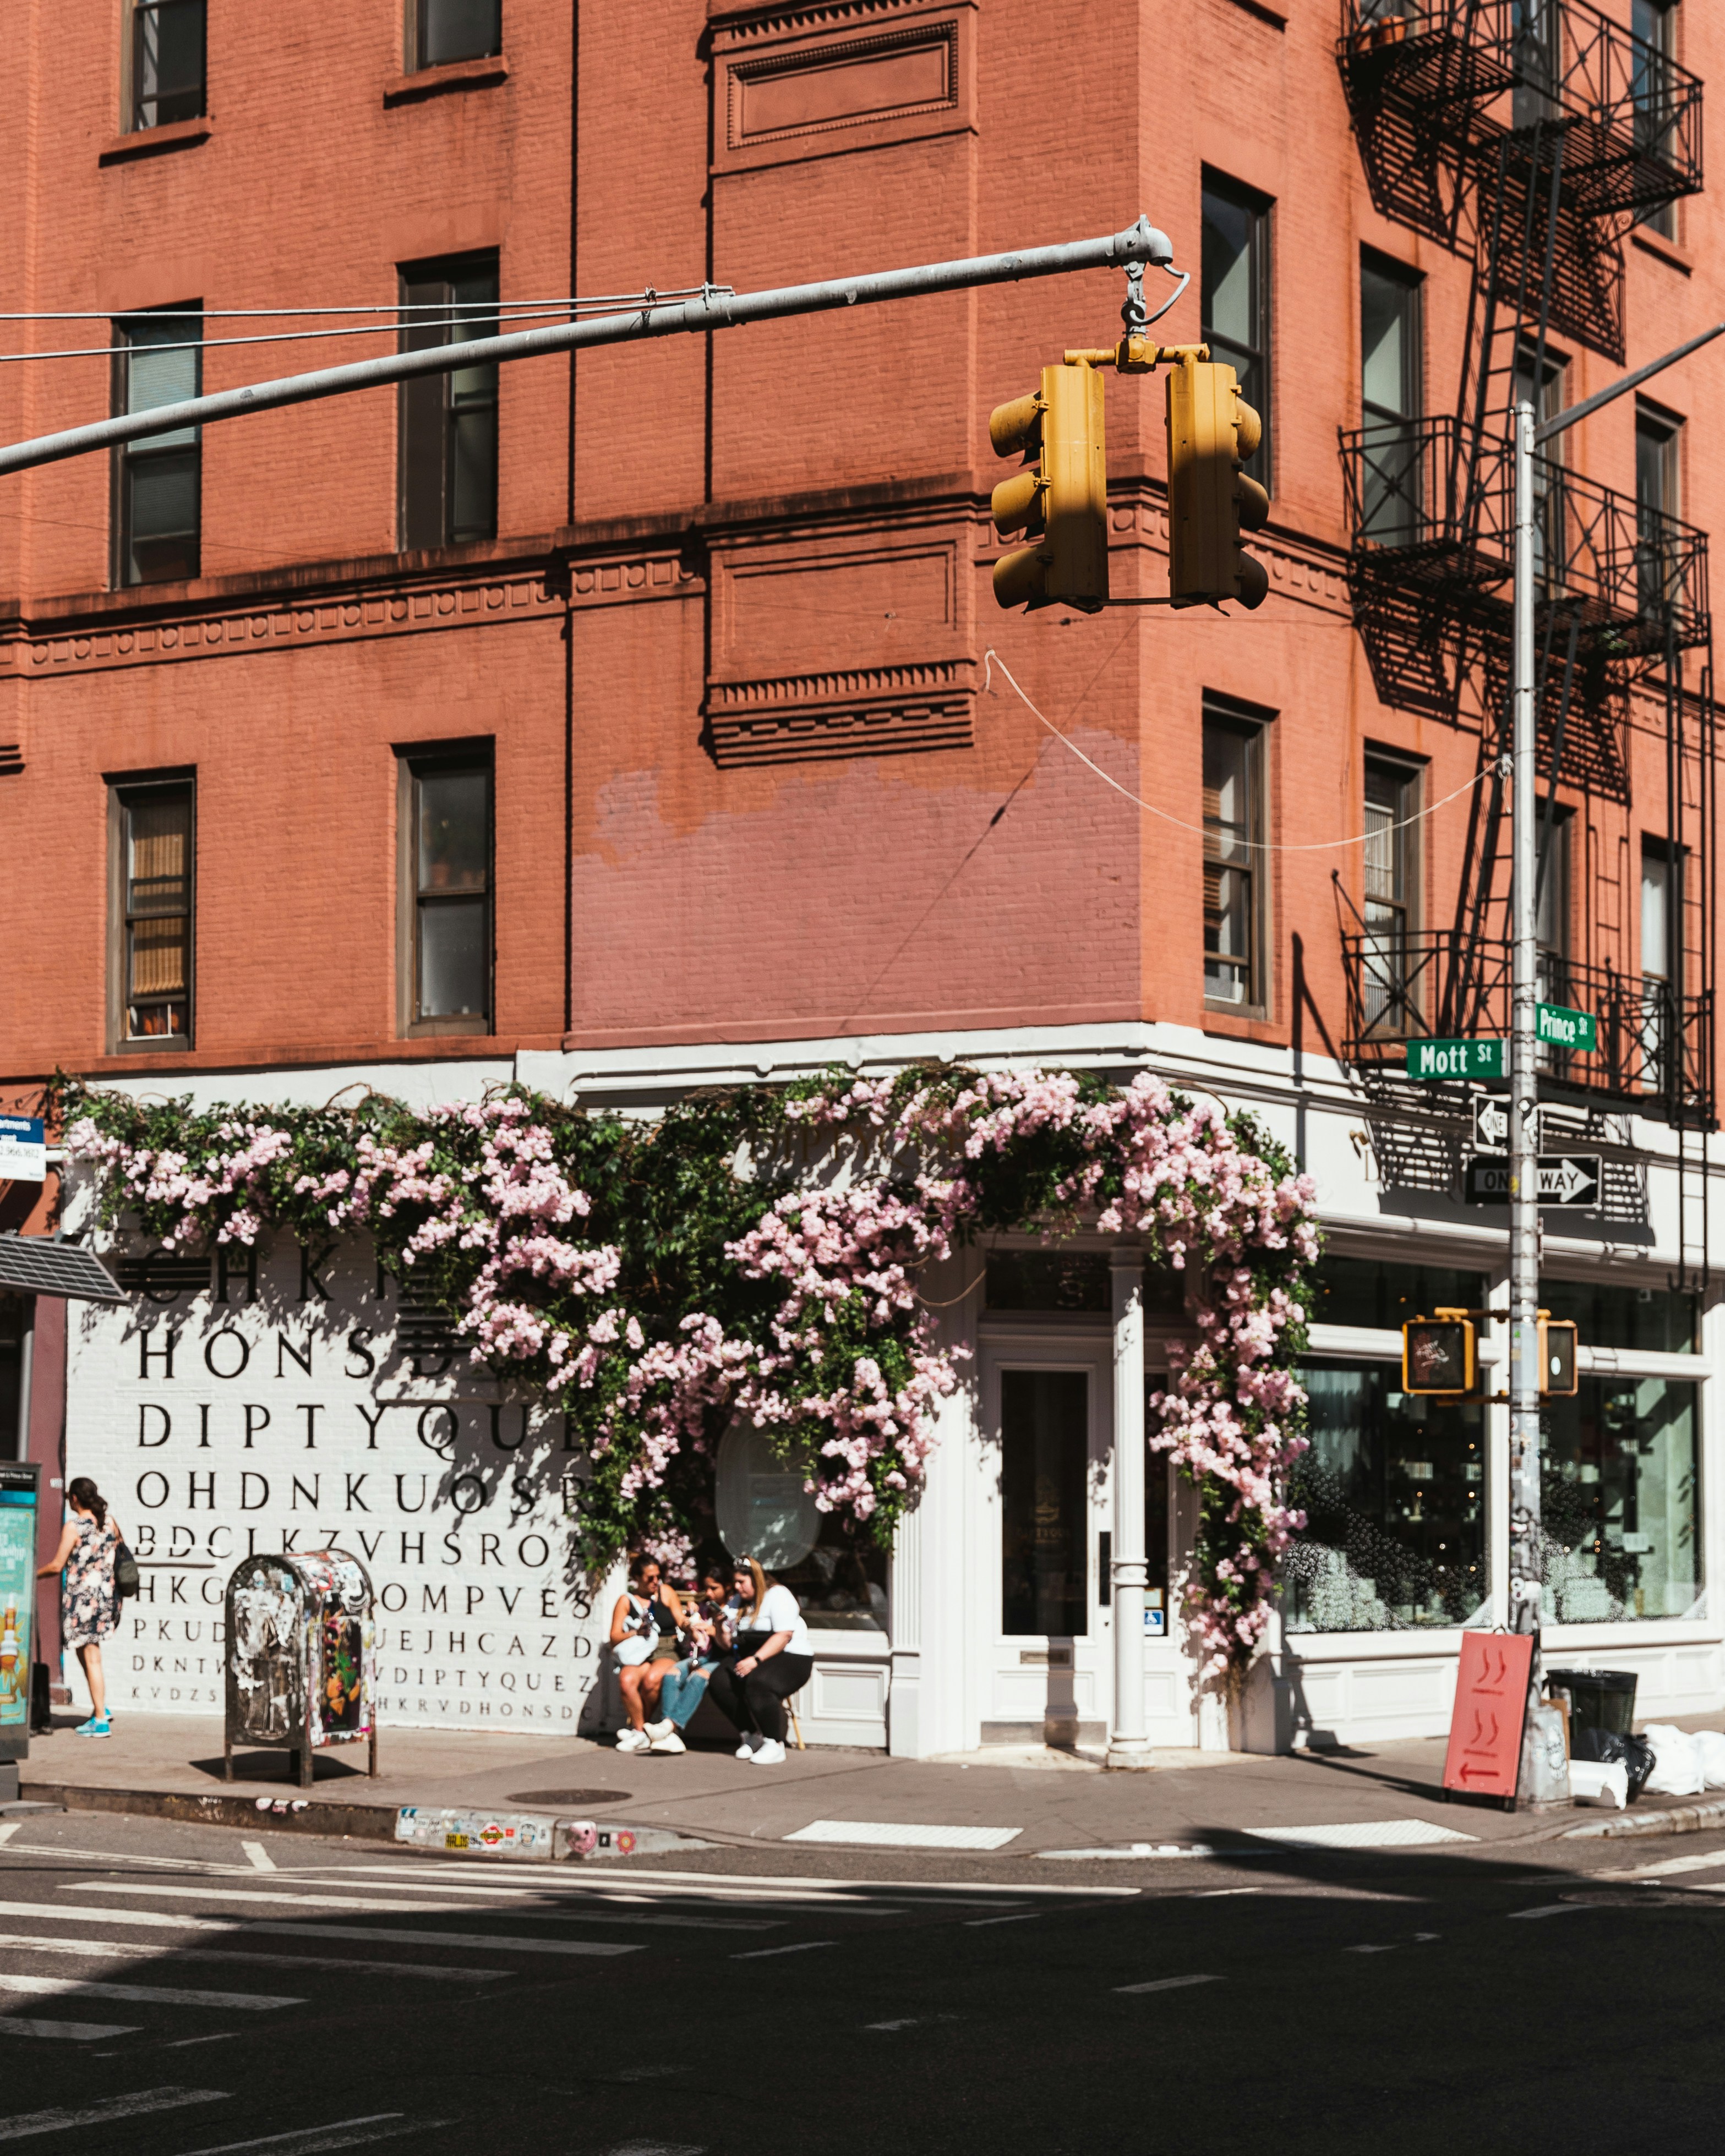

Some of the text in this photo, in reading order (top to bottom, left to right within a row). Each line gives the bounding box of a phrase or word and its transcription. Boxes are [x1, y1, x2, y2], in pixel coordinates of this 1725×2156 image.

[1540, 1008, 1588, 1043] Prince St
[1420, 1043, 1492, 1074] Mott St
[1487, 1113, 1504, 1134] ONE
[1484, 1170, 1578, 1190] ON WAY
